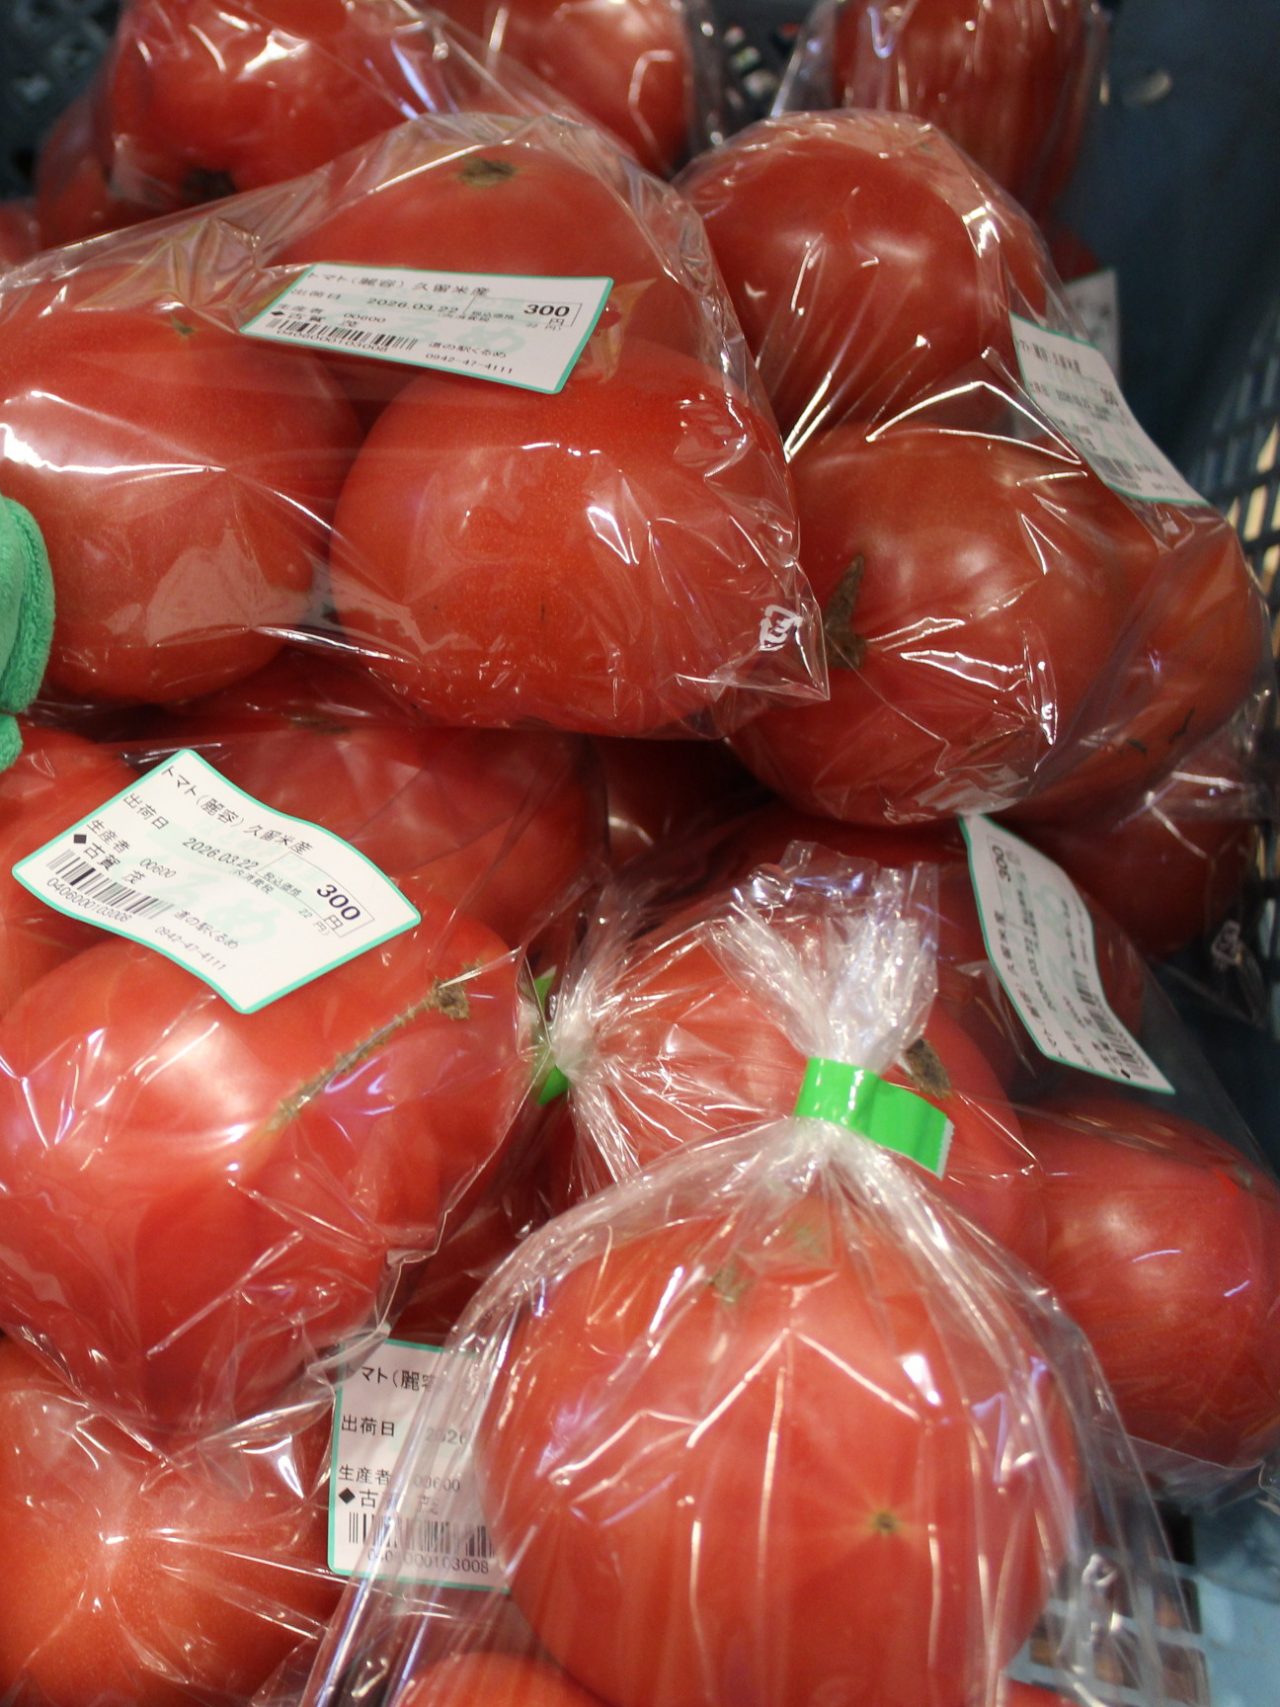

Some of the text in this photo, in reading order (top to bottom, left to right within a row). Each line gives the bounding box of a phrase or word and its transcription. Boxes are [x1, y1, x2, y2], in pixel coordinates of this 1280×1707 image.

[367, 297, 459, 314] 2026.03.22
[524, 304, 570, 318] 300
[123, 793, 169, 830] 出荷日
[182, 837, 260, 871] 2026.03.22
[243, 824, 313, 855] 久留米産
[83, 842, 121, 871] 古賀
[87, 819, 177, 879] 生産者 00600
[992, 845, 1012, 882] 300
[316, 884, 361, 921] 300
[323, 914, 345, 931] 円
[341, 1415, 395, 1437] 出荷日
[338, 1465, 392, 1485] 生産者
